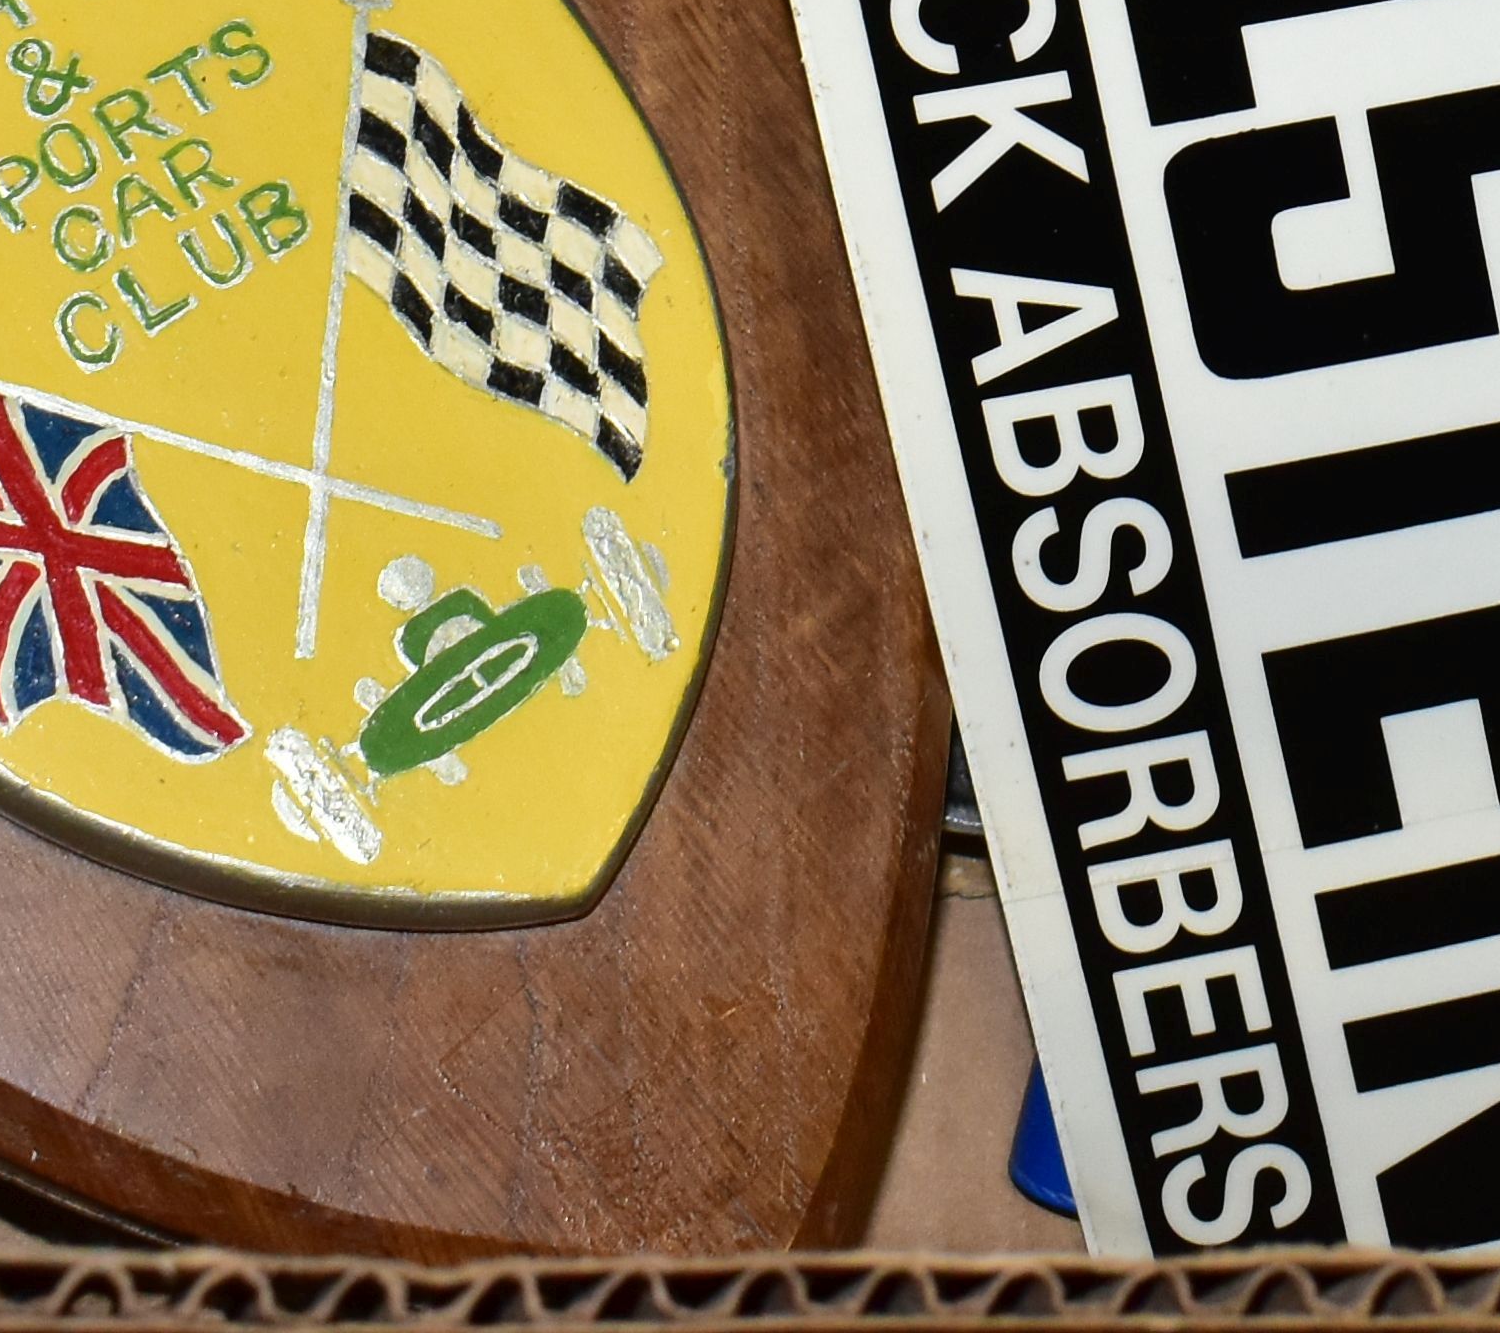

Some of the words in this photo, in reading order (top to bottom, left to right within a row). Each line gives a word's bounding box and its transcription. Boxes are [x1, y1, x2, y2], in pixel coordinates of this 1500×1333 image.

[11, 36, 93, 118] &
[51, 135, 236, 273] CAR
[51, 183, 311, 373] CLUB
[949, 262, 1315, 1249] ABSORBERS
